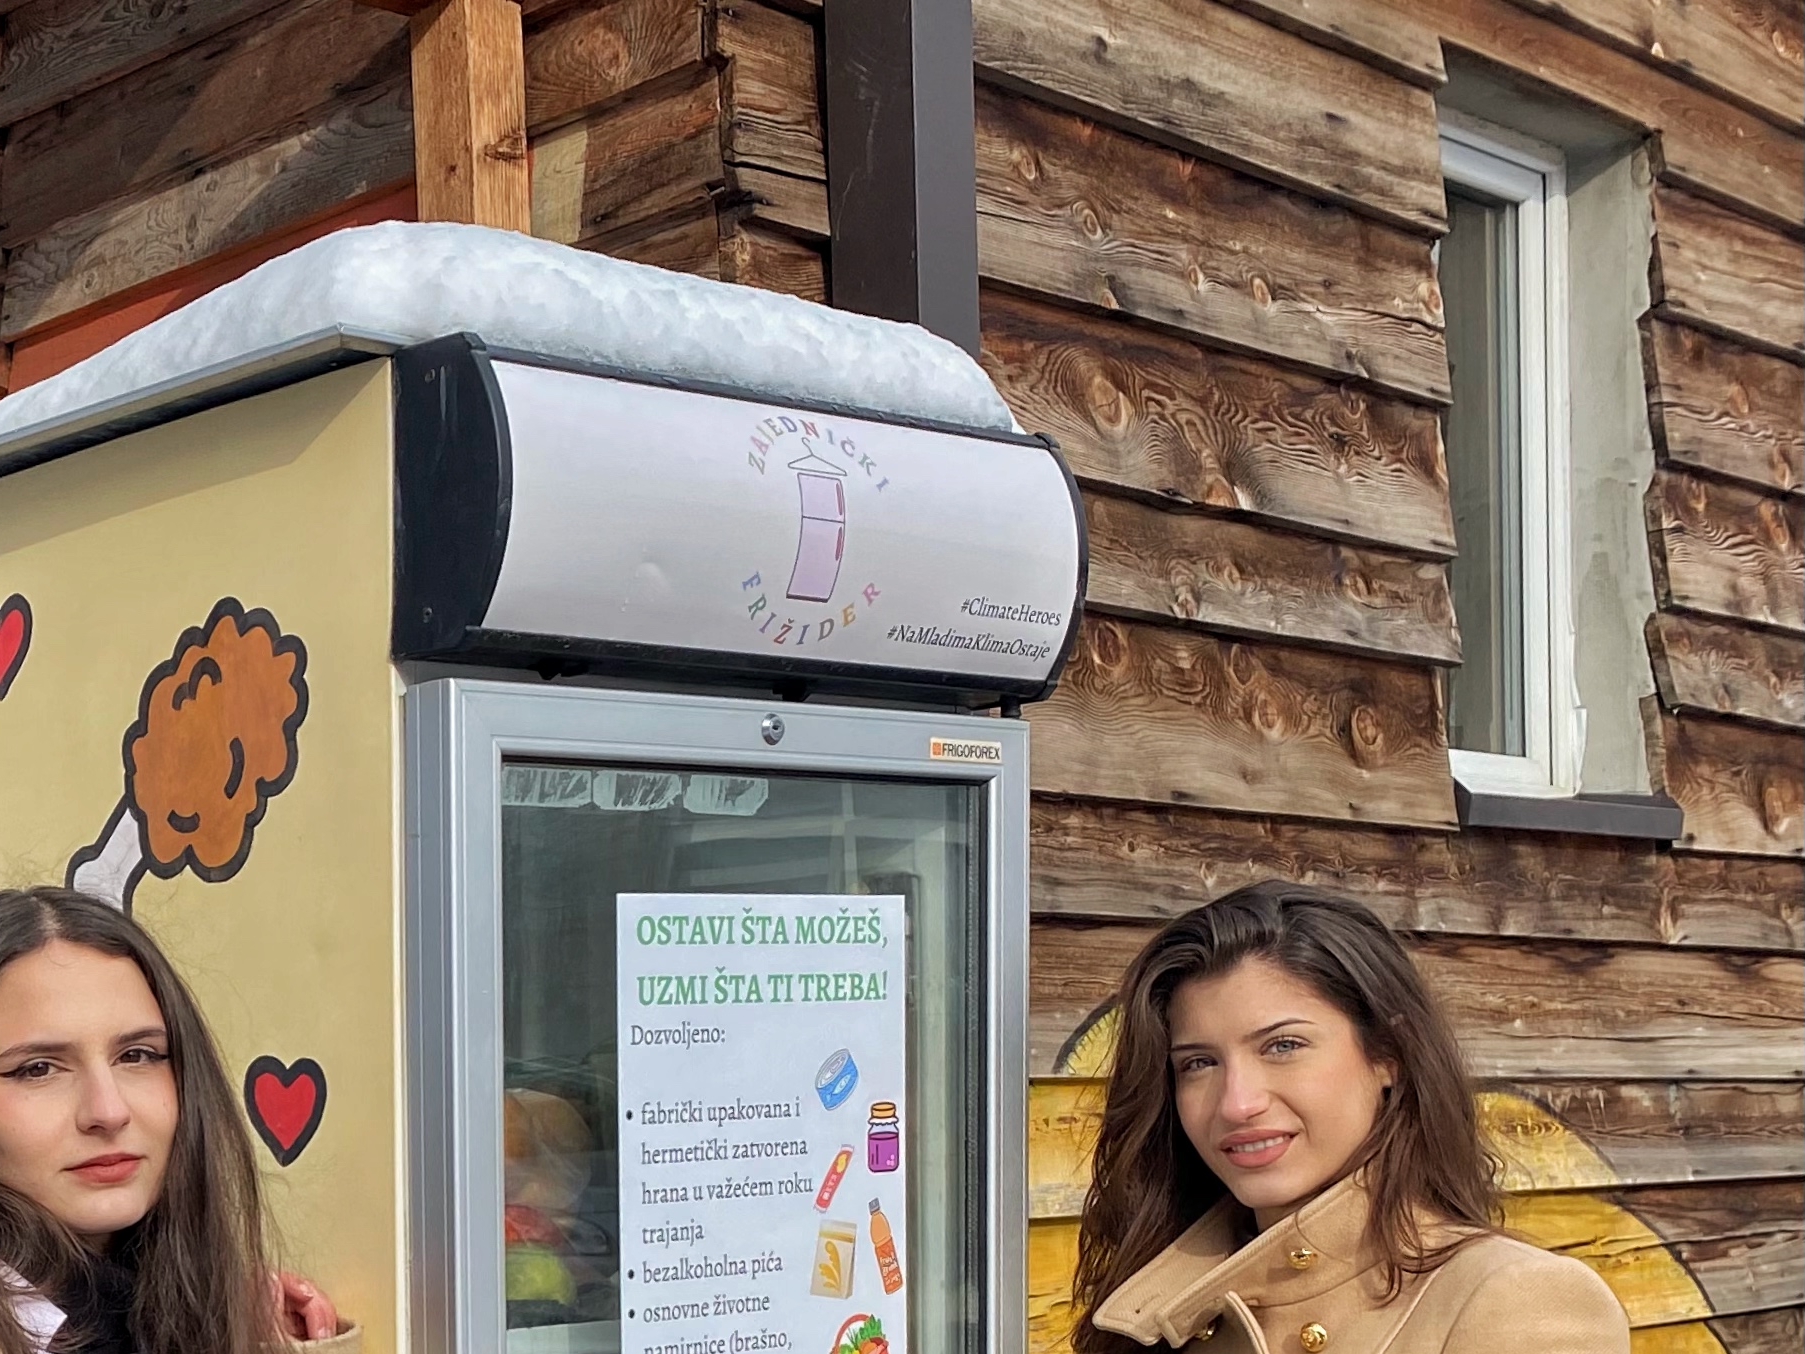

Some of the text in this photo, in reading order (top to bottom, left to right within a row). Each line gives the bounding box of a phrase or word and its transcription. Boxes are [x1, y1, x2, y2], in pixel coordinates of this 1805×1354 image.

[747, 415, 890, 493] ZAJEDNIČKI
[742, 571, 881, 646] FRIŽIDER
[960, 595, 1062, 627] #ClimateHeroes
[886, 624, 1051, 662] #NaMladimaKlimaOstaje
[942, 743, 1001, 760] FRIGOFOREX
[636, 907, 888, 948] OSTAVI ŠTA MOŽEŠ,
[636, 966, 888, 1006] UZMI ŠTA TI TREBA!
[631, 1021, 726, 1049] Dozvoljeno:
[641, 1096, 801, 1127] fabrički upakovana i
[641, 1138, 808, 1164] hermetički zatvorena
[642, 1182, 689, 1204] hrana
[693, 1189, 703, 1201] u
[707, 1176, 774, 1200] važećem
[778, 1172, 813, 1194] roku
[642, 1218, 704, 1249] trajanja
[642, 1250, 783, 1284] bezalkoholna pića
[644, 1294, 770, 1323] osnovne životne
